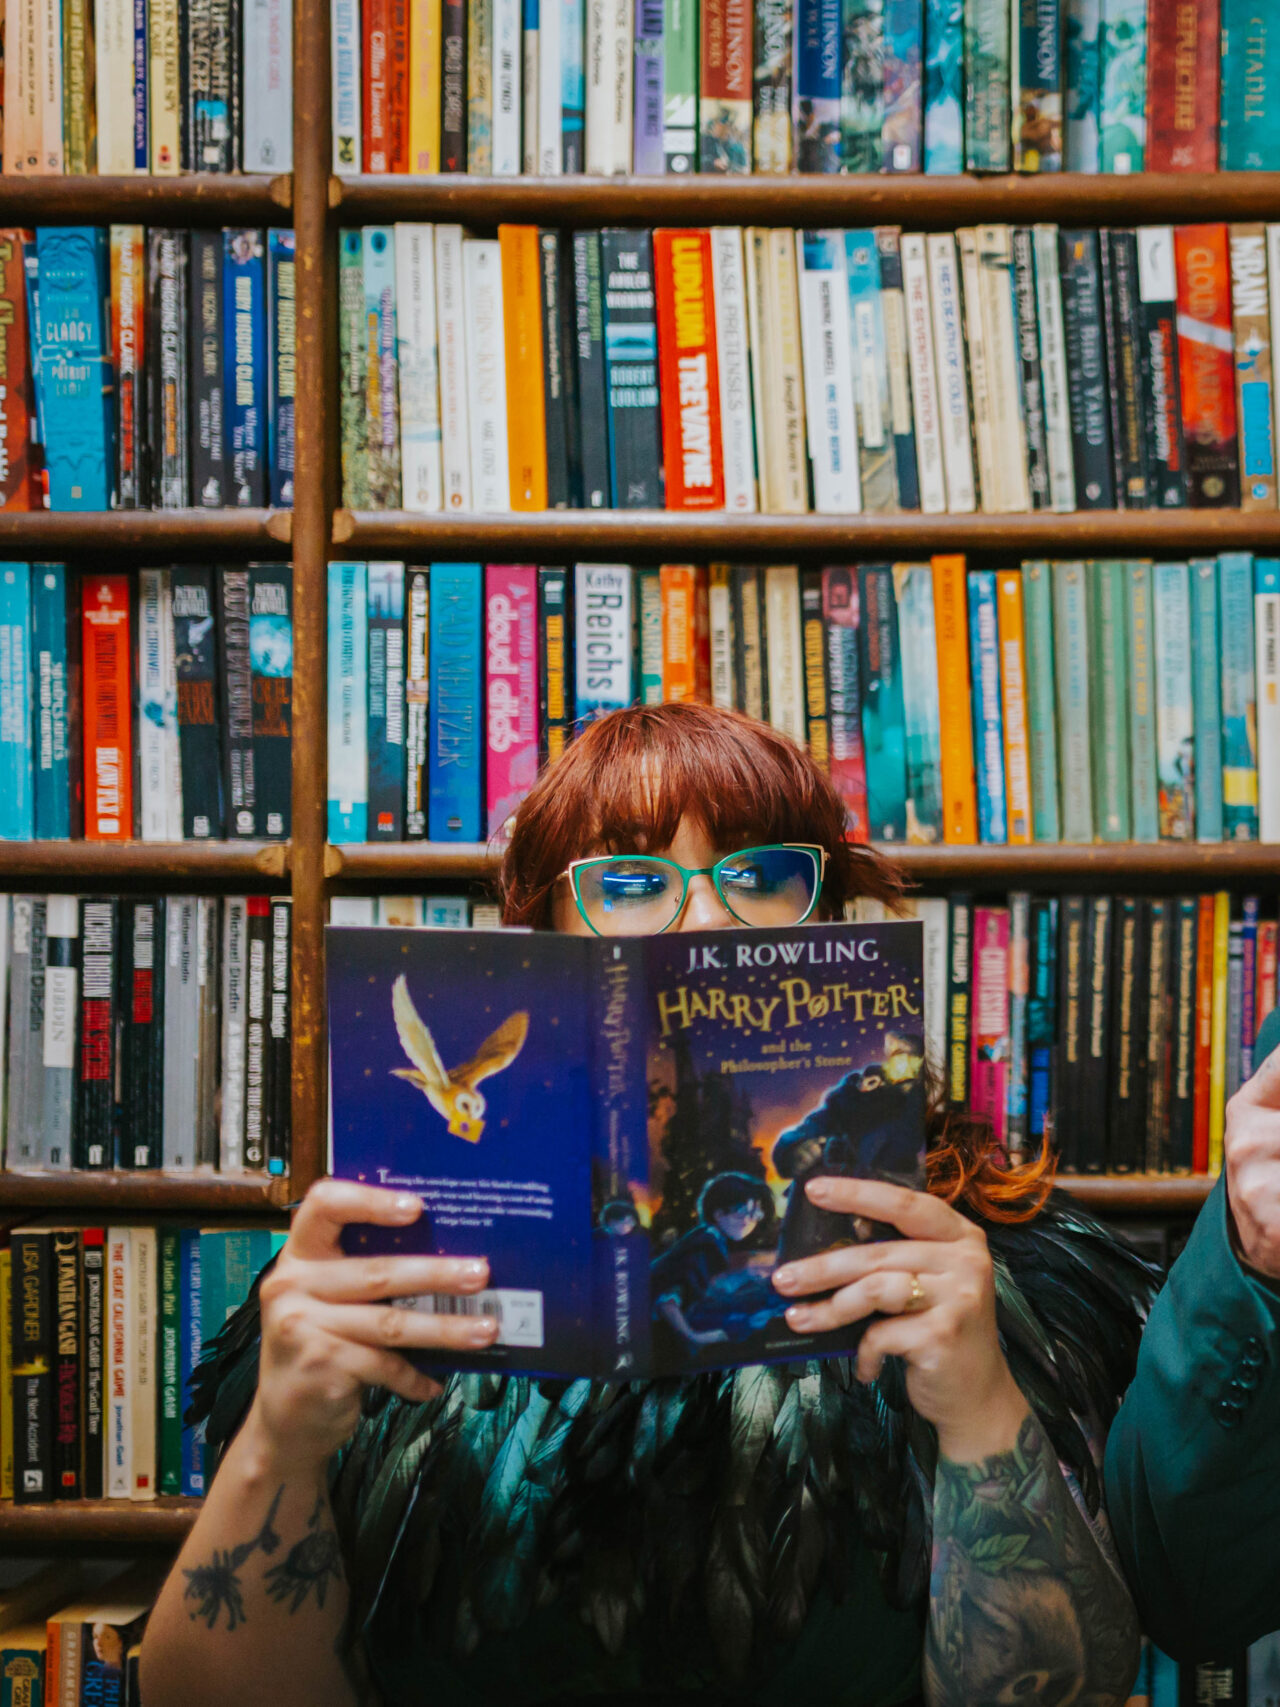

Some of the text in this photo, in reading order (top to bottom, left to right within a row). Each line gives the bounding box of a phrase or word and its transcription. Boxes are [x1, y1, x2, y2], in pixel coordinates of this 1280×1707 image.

[165, 90, 177, 113] SPY
[161, 239, 175, 276] MARY
[277, 262, 295, 297] MARY
[1186, 247, 1217, 318] CLOUD
[121, 276, 133, 328] HIGGINS
[161, 279, 175, 331] HIGGINS
[278, 299, 295, 353] HIGGINS
[719, 241, 743, 411] FALSE PRETENSES
[121, 330, 133, 375] CLARK
[161, 333, 176, 379] CLARK
[236, 276, 252, 406] MARY HIGGINS CLARK
[671, 237, 713, 489] LUDLUM TREVAYNE
[1081, 325, 1100, 379] BIRD
[278, 355, 296, 397] CLARK
[1085, 385, 1104, 446] YARD
[223, 571, 248, 620] BODY
[585, 569, 623, 589] Kathy
[225, 622, 249, 647] OF
[386, 629, 402, 667] BRIAN
[586, 593, 624, 690] Reichs
[370, 629, 384, 718] GALLOWS LANE
[438, 578, 474, 768] BRAD MELTZER
[489, 594, 520, 752] cloud atlas
[520, 602, 533, 742] DAVID MITCHELL
[829, 625, 846, 761] PROPERTY OF BLOOD
[842, 627, 858, 714] MAGDALEN
[14, 902, 30, 954] Cabal
[83, 903, 112, 997] MICHAEL DIBDIN
[687, 940, 879, 974] J.K. ROWLING
[30, 902, 45, 1032] Michael Dibdin
[229, 905, 241, 1013] Michael Dibdin
[272, 938, 287, 991] DICKINSON
[953, 936, 967, 983] PHILLIPS
[53, 972, 67, 1041] DIBDIN
[657, 978, 920, 1037] HARRY POTTER
[953, 993, 967, 1015] THE
[979, 948, 1006, 1036] CONFESSION
[761, 1040, 812, 1054] and the
[952, 1017, 966, 1041] LATE
[720, 1055, 853, 1074] Philosopher's Stone
[22, 1243, 40, 1341] LISA GARDNER
[58, 1254, 77, 1355] JONATHAN GASH
[87, 1274, 100, 1368] JONATHAN GASH
[113, 1243, 124, 1398] THE GREAT CALIFORNIA GAME
[615, 1272, 630, 1345] ROWLING
[27, 1378, 39, 1463] The Next Accident
[66, 1631, 76, 1688] GRAHAM
